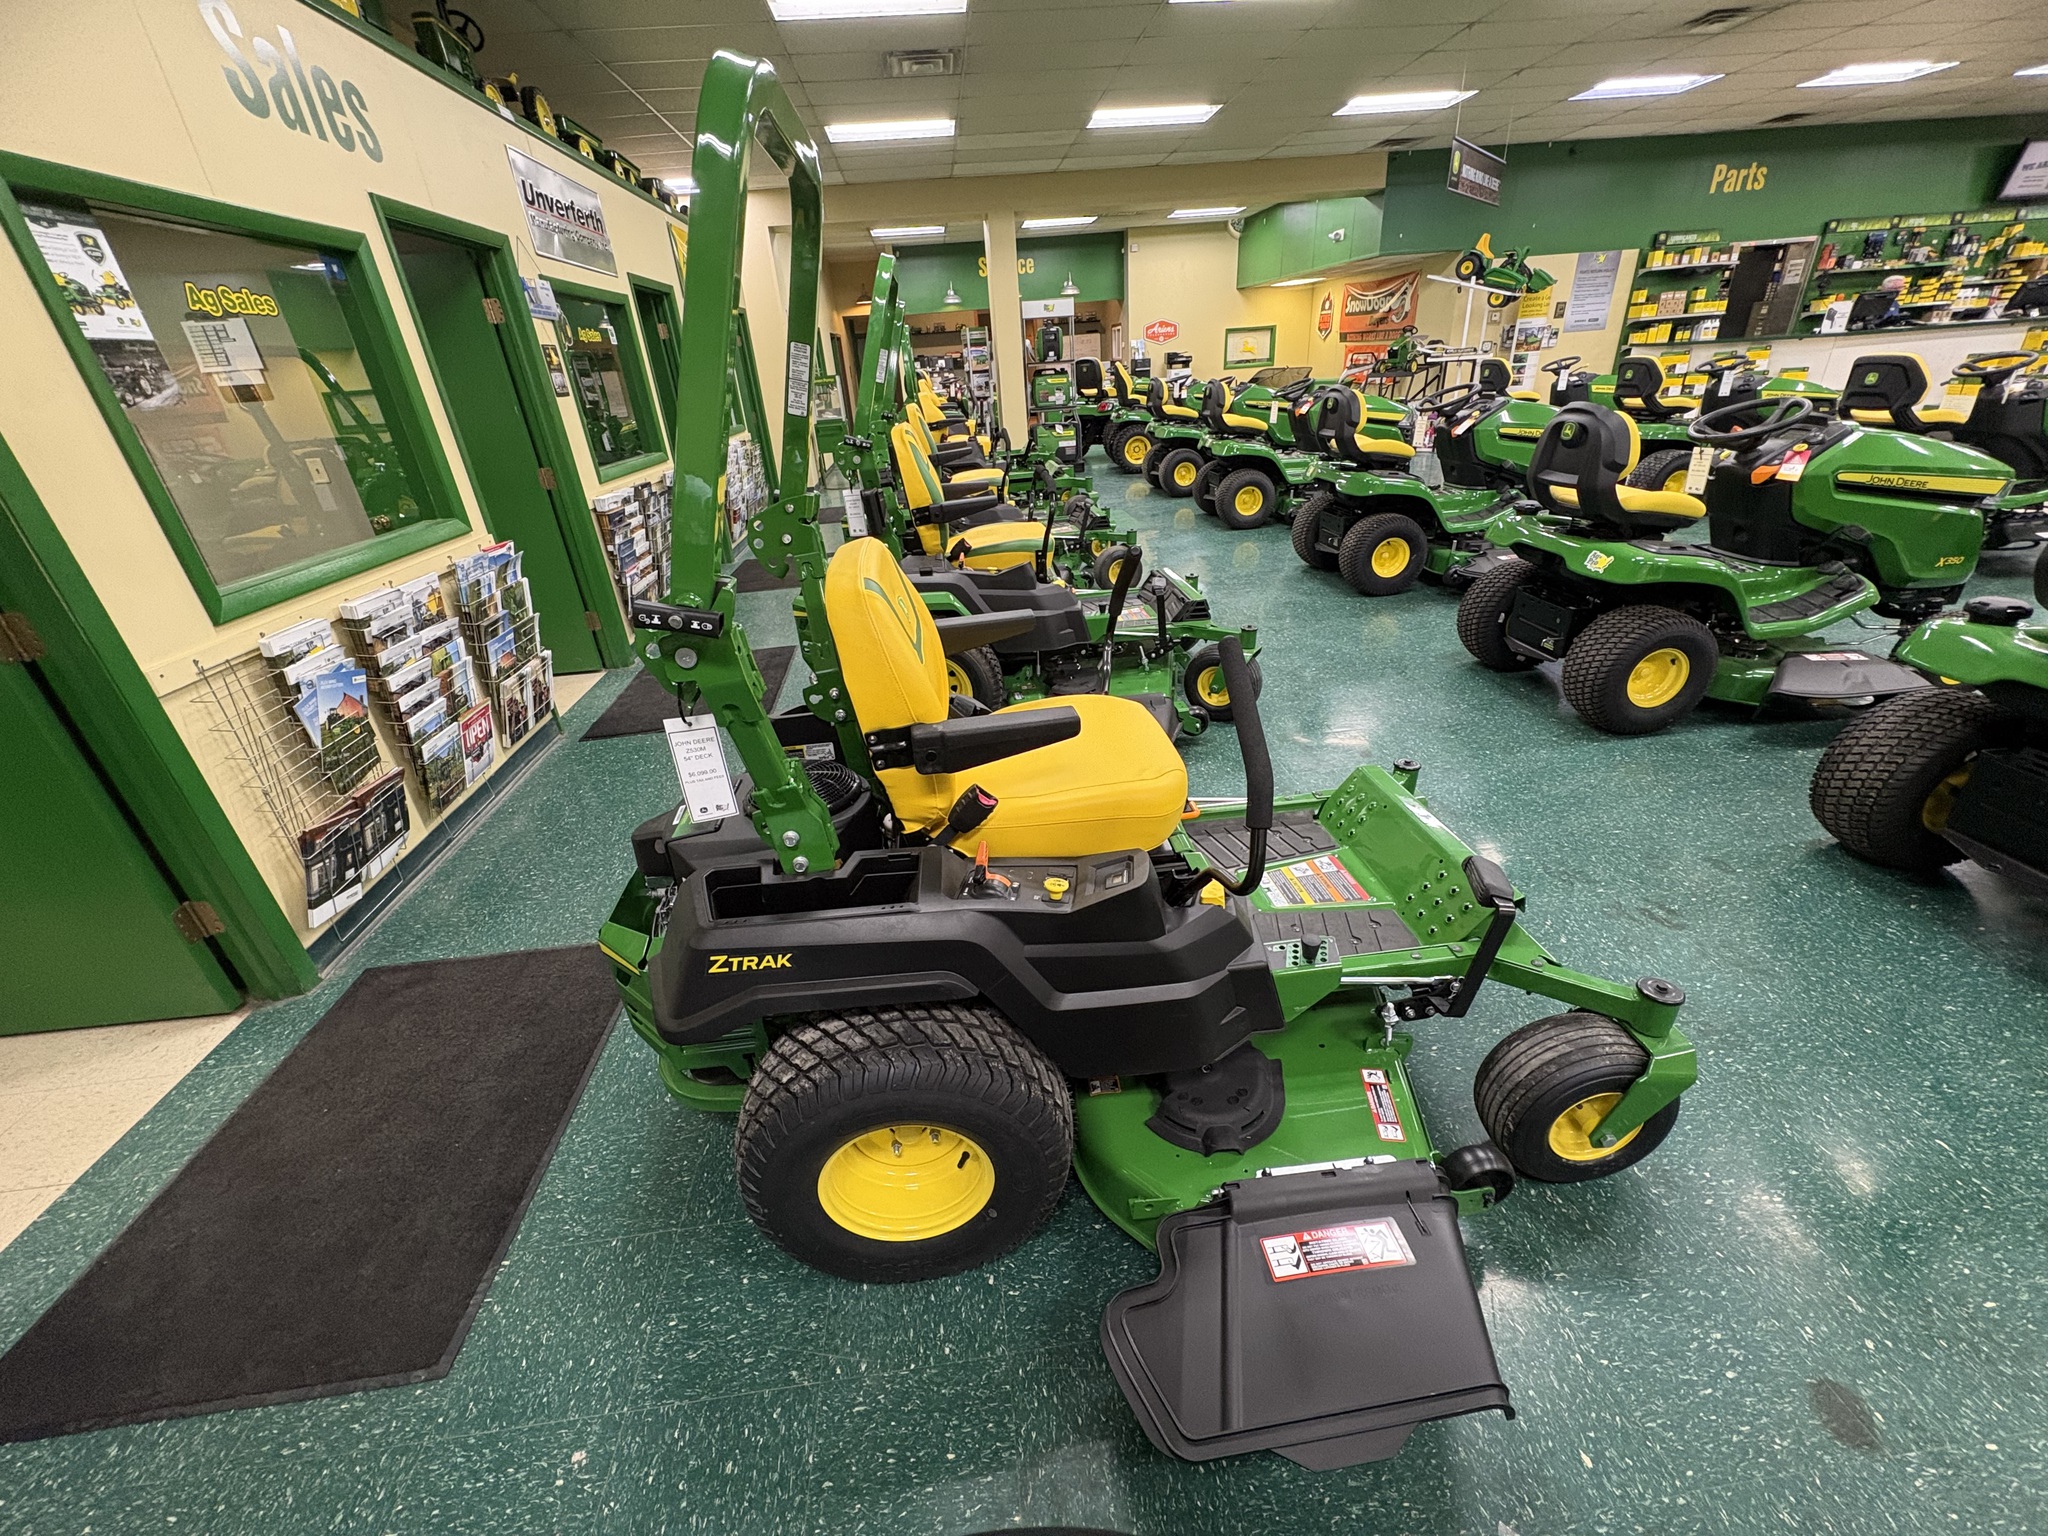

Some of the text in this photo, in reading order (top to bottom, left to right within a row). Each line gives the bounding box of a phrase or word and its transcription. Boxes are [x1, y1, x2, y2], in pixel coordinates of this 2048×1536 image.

[197, 0, 384, 163] Sales
[1709, 162, 1768, 194] Parts
[521, 179, 604, 233] Unverferth
[184, 281, 279, 317] Ag Sales
[577, 326, 602, 343] Ag Sales
[1147, 322, 1175, 334] Ariens
[1866, 475, 1929, 489] JOHN DEERE
[1935, 556, 1965, 567] X350
[674, 736, 716, 748] JOHN DEERE
[686, 746, 707, 754] Z530M
[694, 753, 713, 761] DECK
[708, 953, 793, 974] ZTRAK
[1311, 1228, 1349, 1239] DANGER
